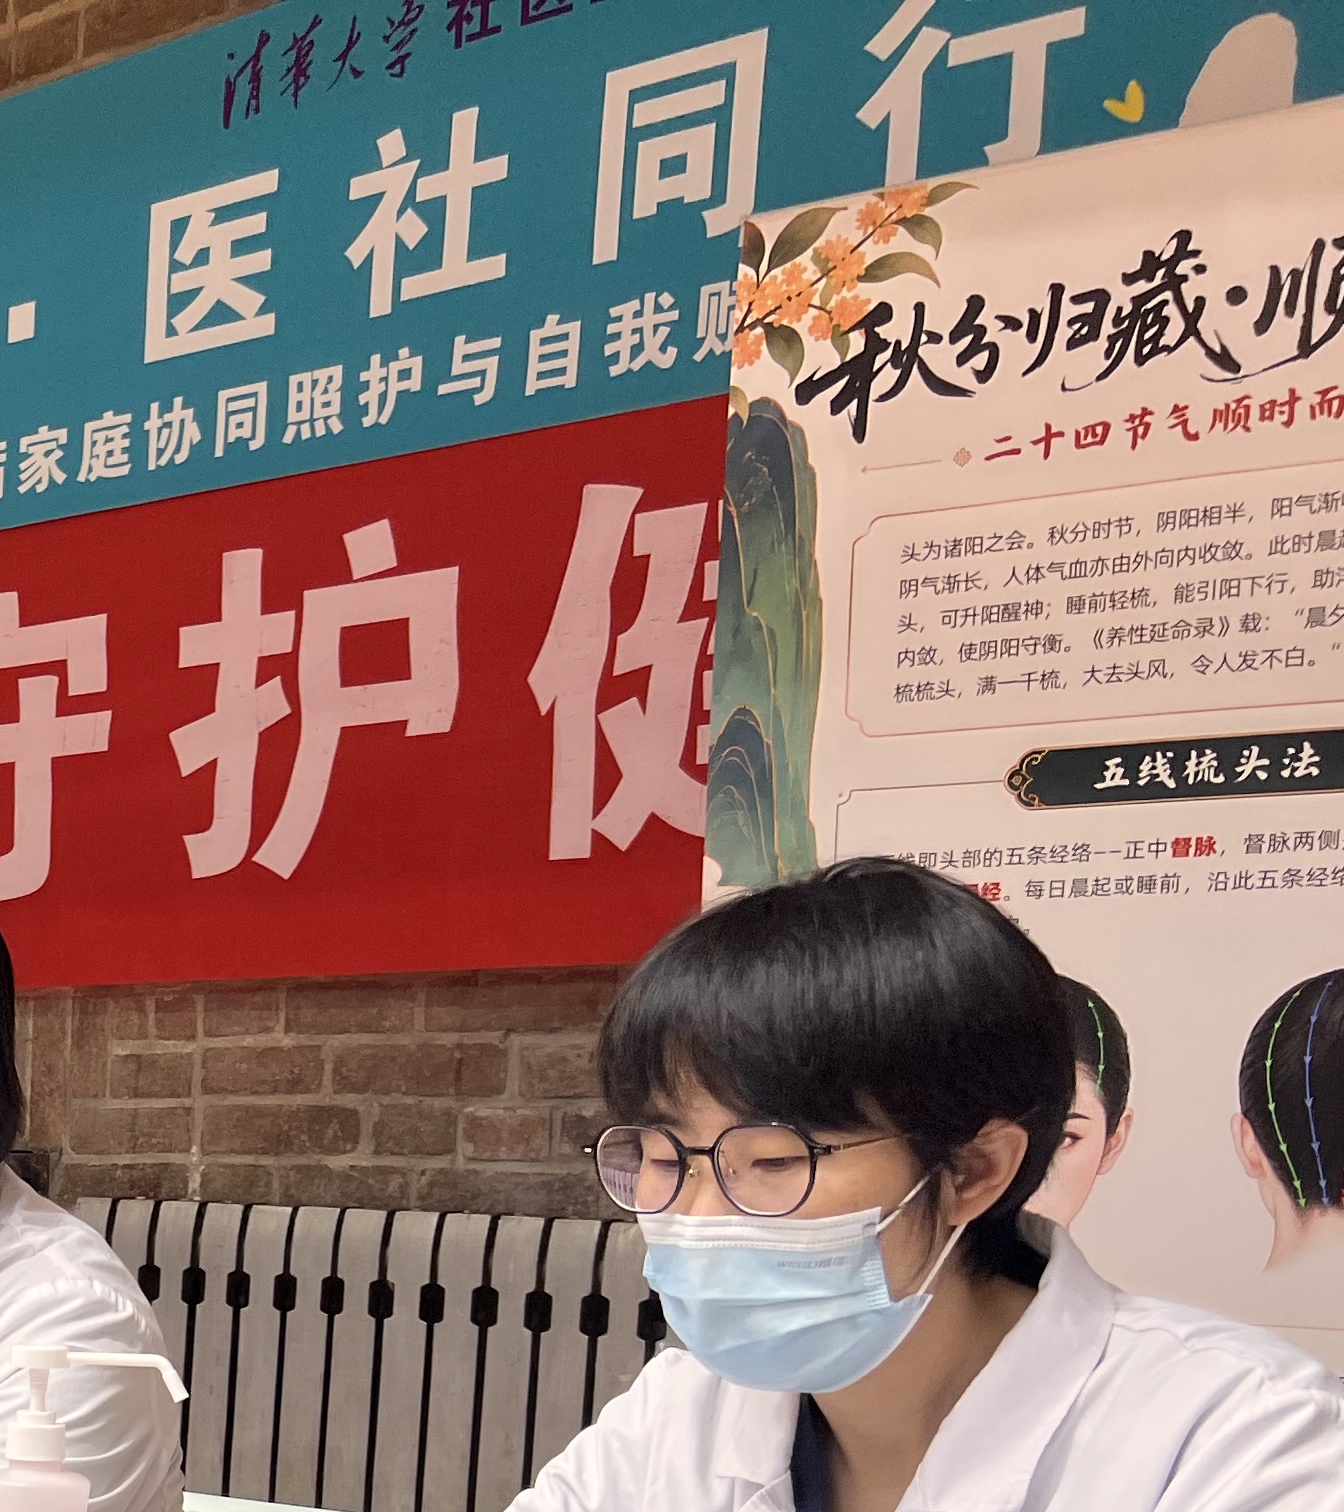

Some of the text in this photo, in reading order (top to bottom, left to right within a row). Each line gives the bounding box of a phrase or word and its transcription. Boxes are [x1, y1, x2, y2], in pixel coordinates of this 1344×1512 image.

[1093, 740, 1323, 790] 五线梳头法
